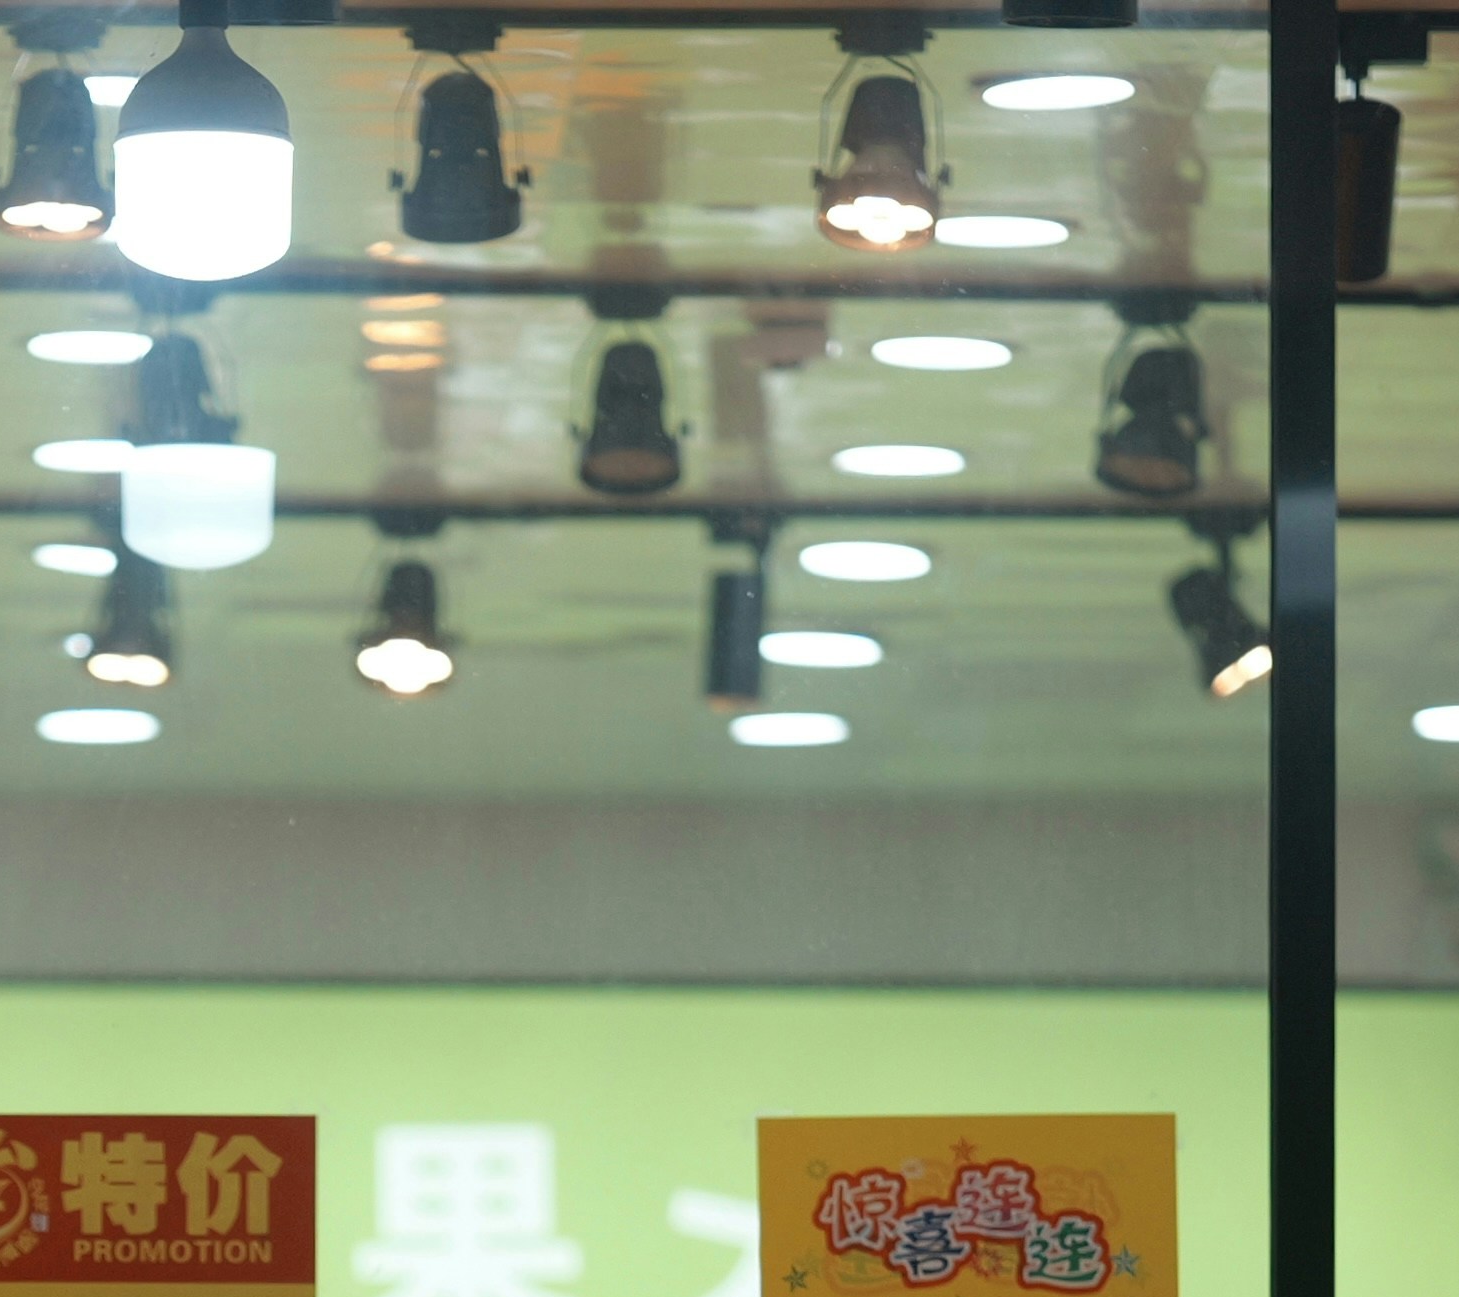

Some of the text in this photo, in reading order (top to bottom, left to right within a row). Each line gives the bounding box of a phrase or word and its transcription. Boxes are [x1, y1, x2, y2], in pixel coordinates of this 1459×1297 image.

[60, 1132, 283, 1236] 特价
[814, 1160, 1108, 1290] 惊喜连连
[74, 1239, 273, 1264] PROMOTION
